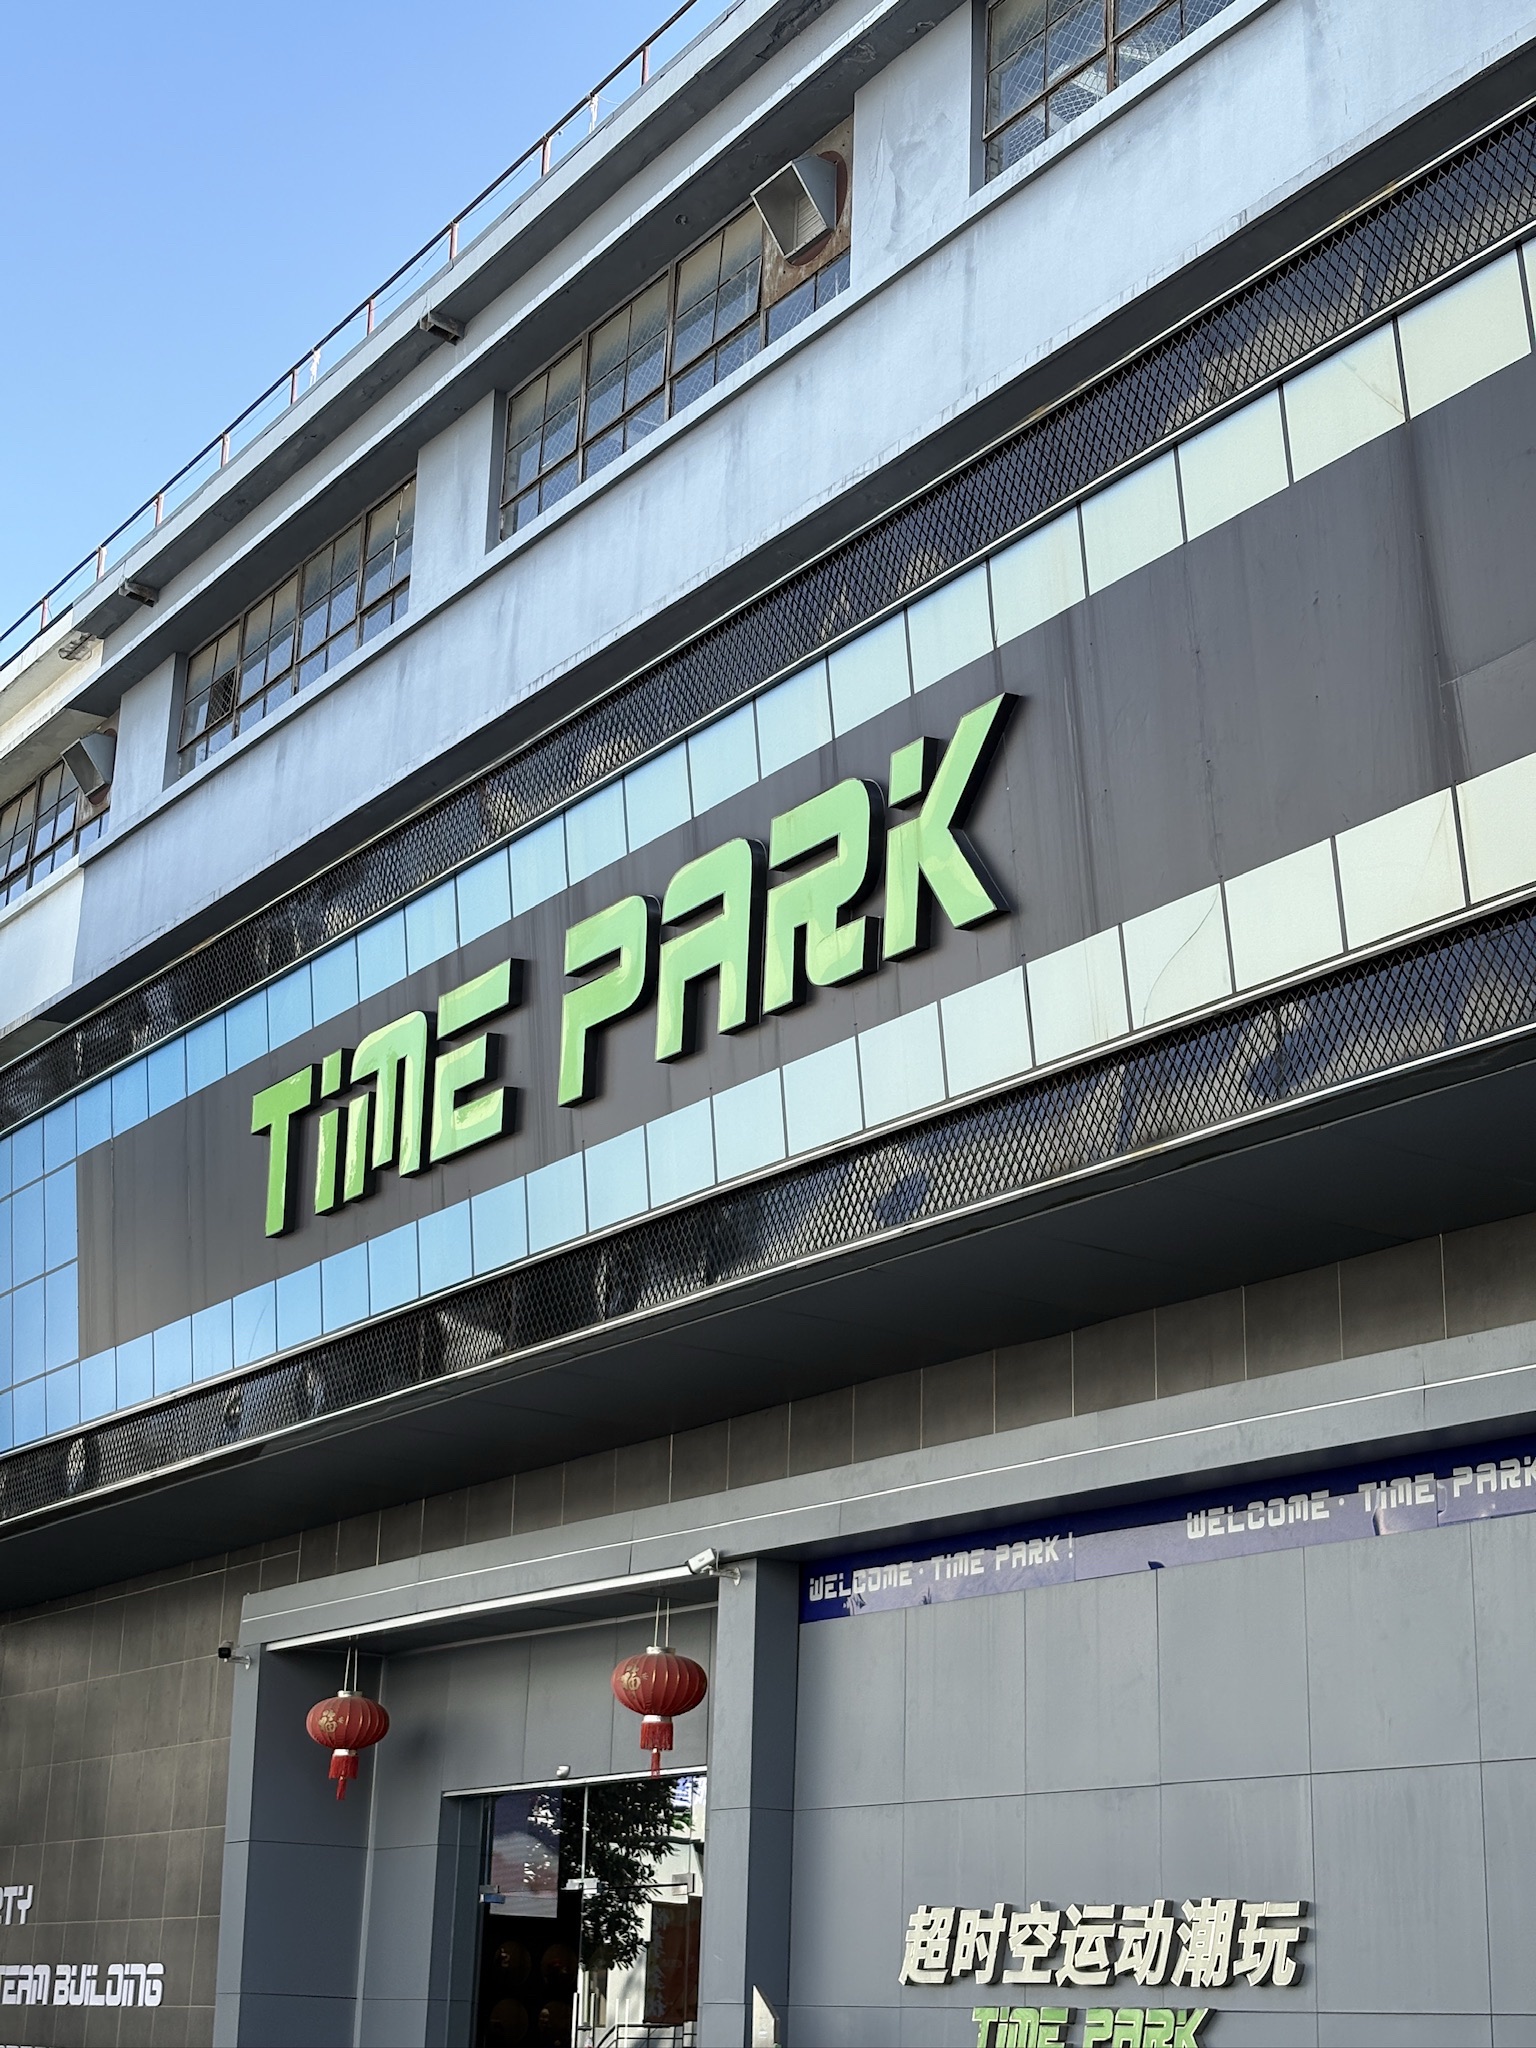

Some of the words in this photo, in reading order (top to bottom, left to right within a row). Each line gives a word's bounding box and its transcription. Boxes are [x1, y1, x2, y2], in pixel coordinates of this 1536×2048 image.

[252, 957, 518, 1238] TIME
[558, 692, 1012, 1108] PARK
[1186, 1490, 1330, 1539] WELCOME
[1358, 1473, 1435, 1512] TIME
[809, 1561, 914, 1601] WELCOME
[931, 1548, 984, 1580] TIME
[0, 1885, 34, 1925] TY
[898, 1897, 1303, 1987] 超时空运动潮玩
[53, 1963, 165, 2006] BUILDING
